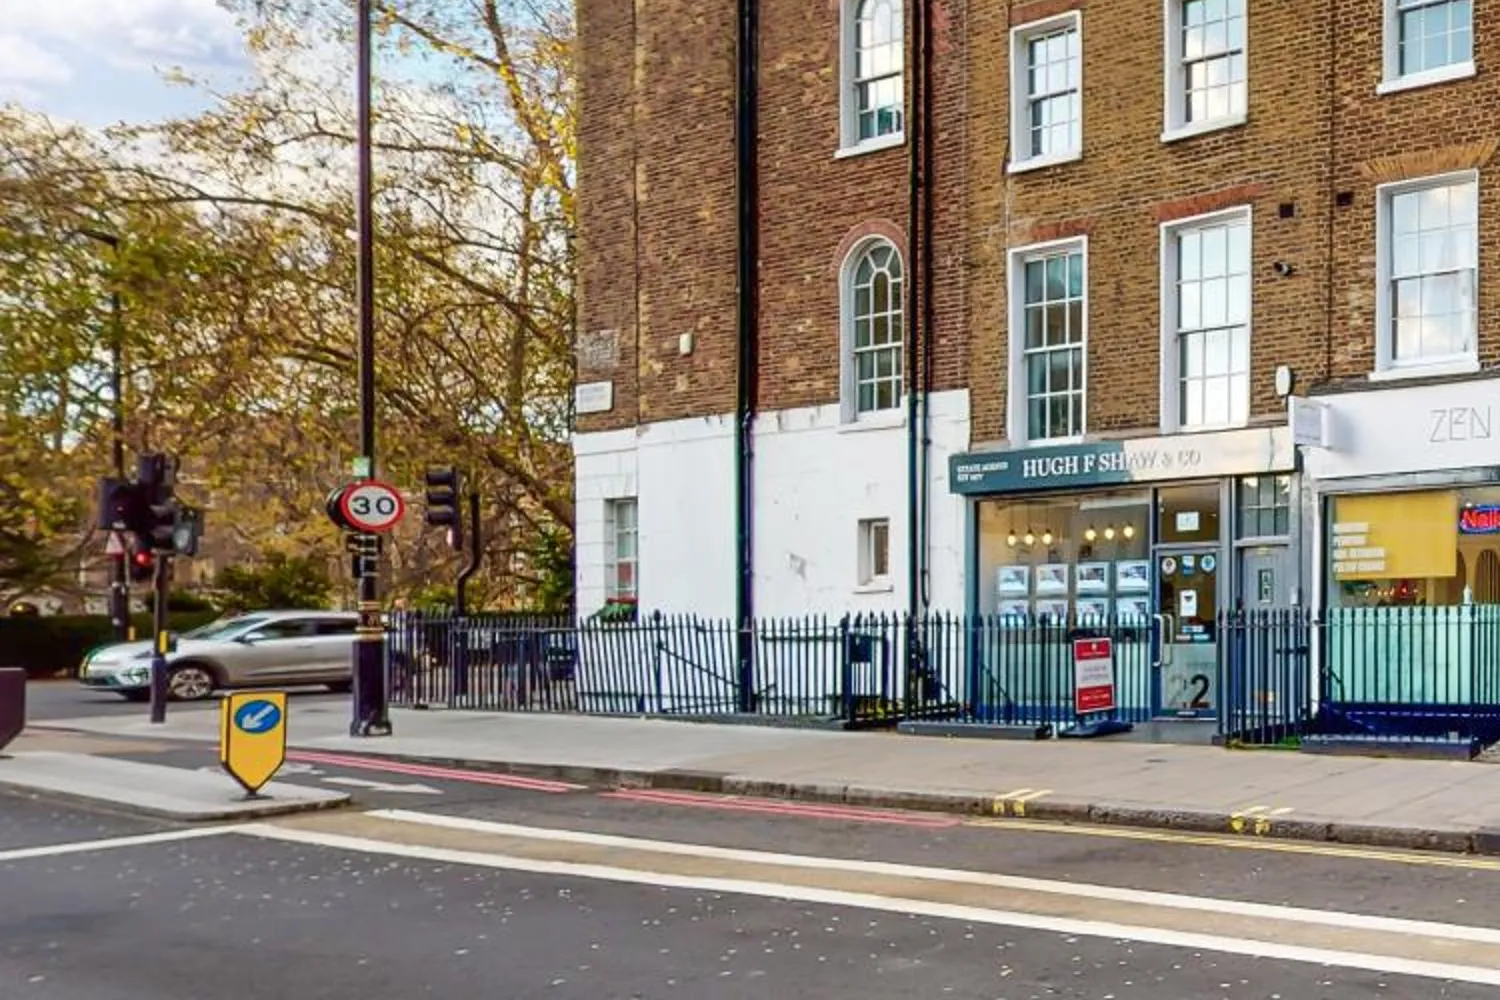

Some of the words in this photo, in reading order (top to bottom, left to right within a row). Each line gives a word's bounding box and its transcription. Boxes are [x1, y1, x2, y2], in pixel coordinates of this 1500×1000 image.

[1429, 405, 1491, 443] ZEN
[1022, 455, 1080, 479] HUGH
[1083, 455, 1096, 474] F
[1098, 450, 1158, 473] SHAW
[352, 496, 396, 515] 30
